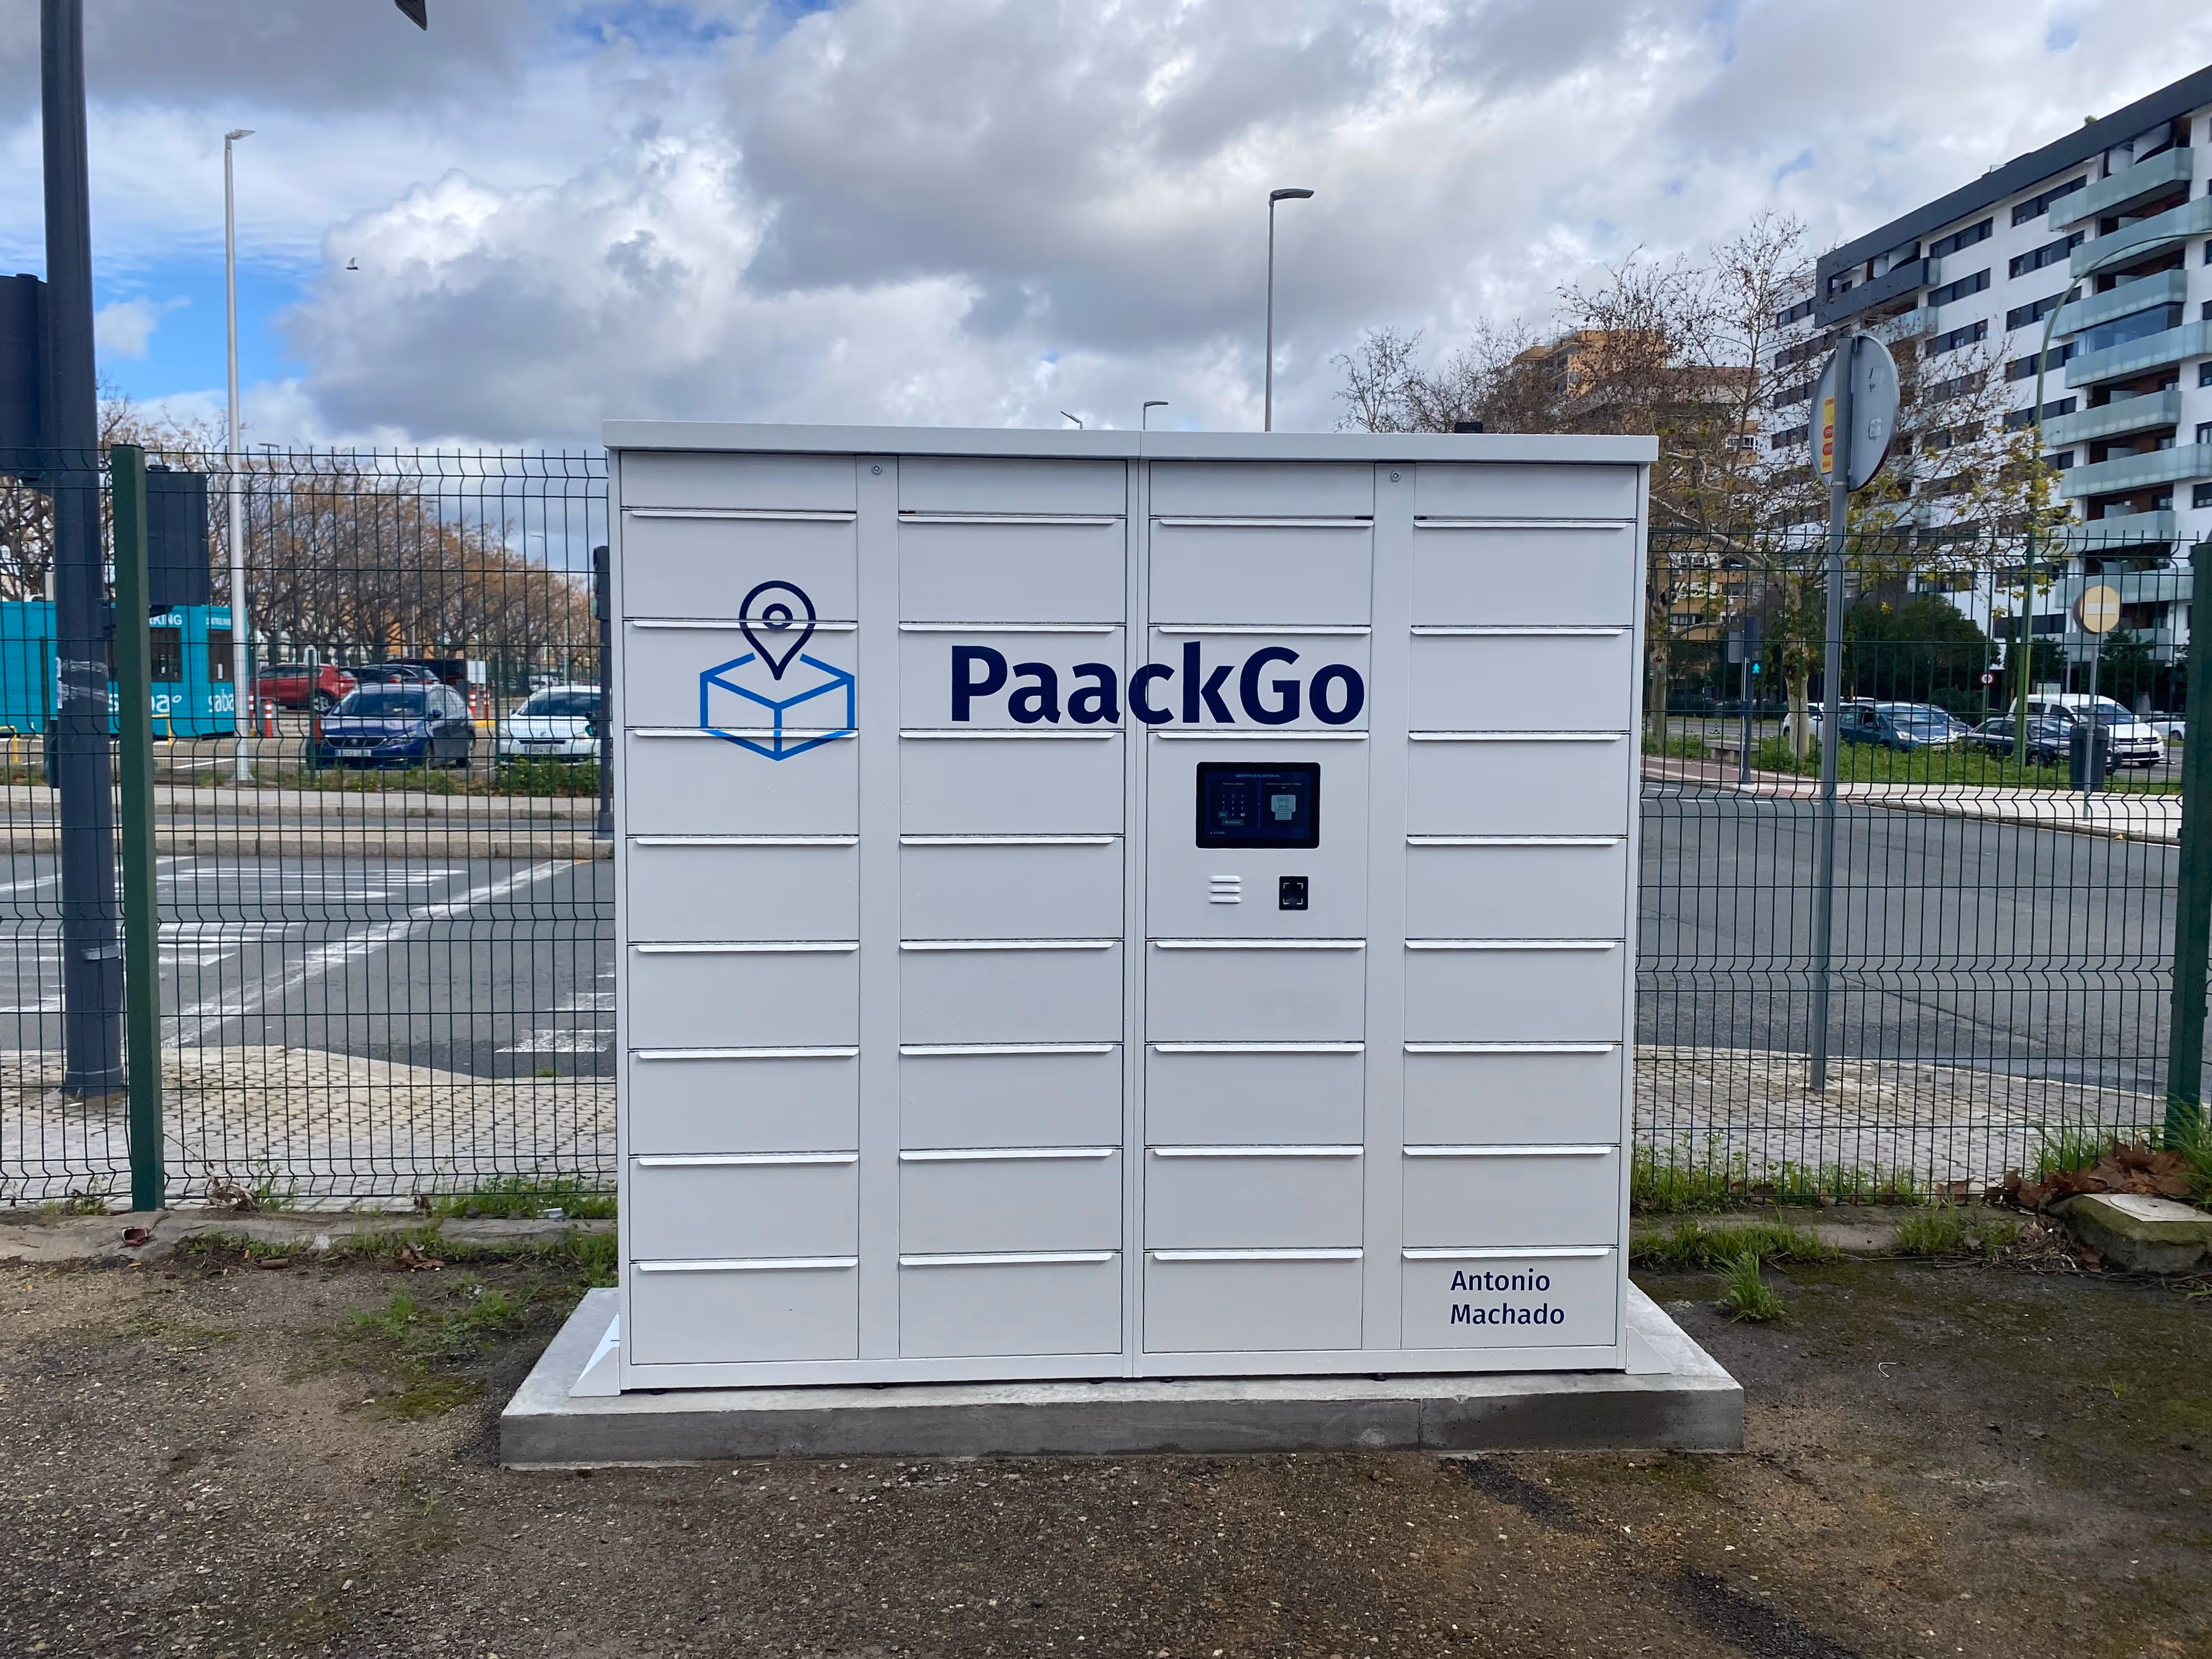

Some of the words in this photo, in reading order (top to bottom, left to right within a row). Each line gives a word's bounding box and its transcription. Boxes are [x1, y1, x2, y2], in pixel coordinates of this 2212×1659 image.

[951, 641, 1365, 725] PaackGo
[1450, 1268, 1550, 1292] Antonio
[1450, 1303, 1565, 1324] Machado
